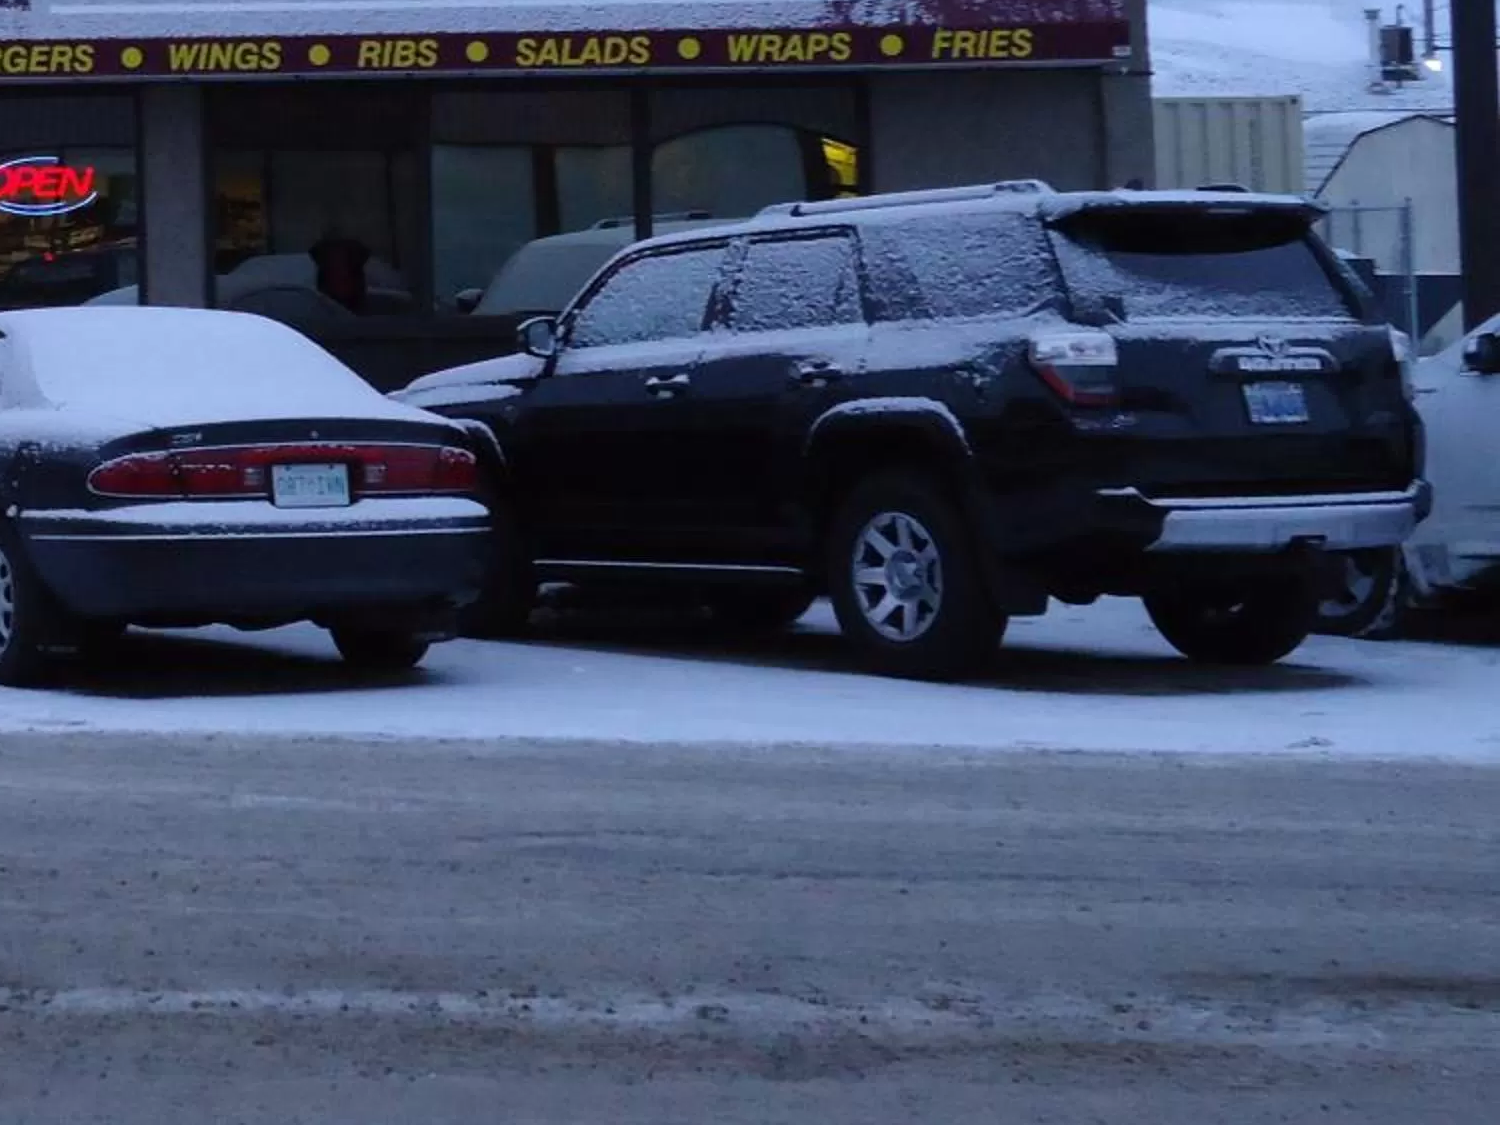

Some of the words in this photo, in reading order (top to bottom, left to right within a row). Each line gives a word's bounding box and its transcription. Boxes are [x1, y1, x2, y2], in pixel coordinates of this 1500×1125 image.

[168, 42, 283, 72] WINGS
[357, 40, 439, 69] RIBS
[515, 37, 651, 66] SALADS
[727, 32, 853, 63] WRAPS
[931, 29, 1034, 60] FRIES
